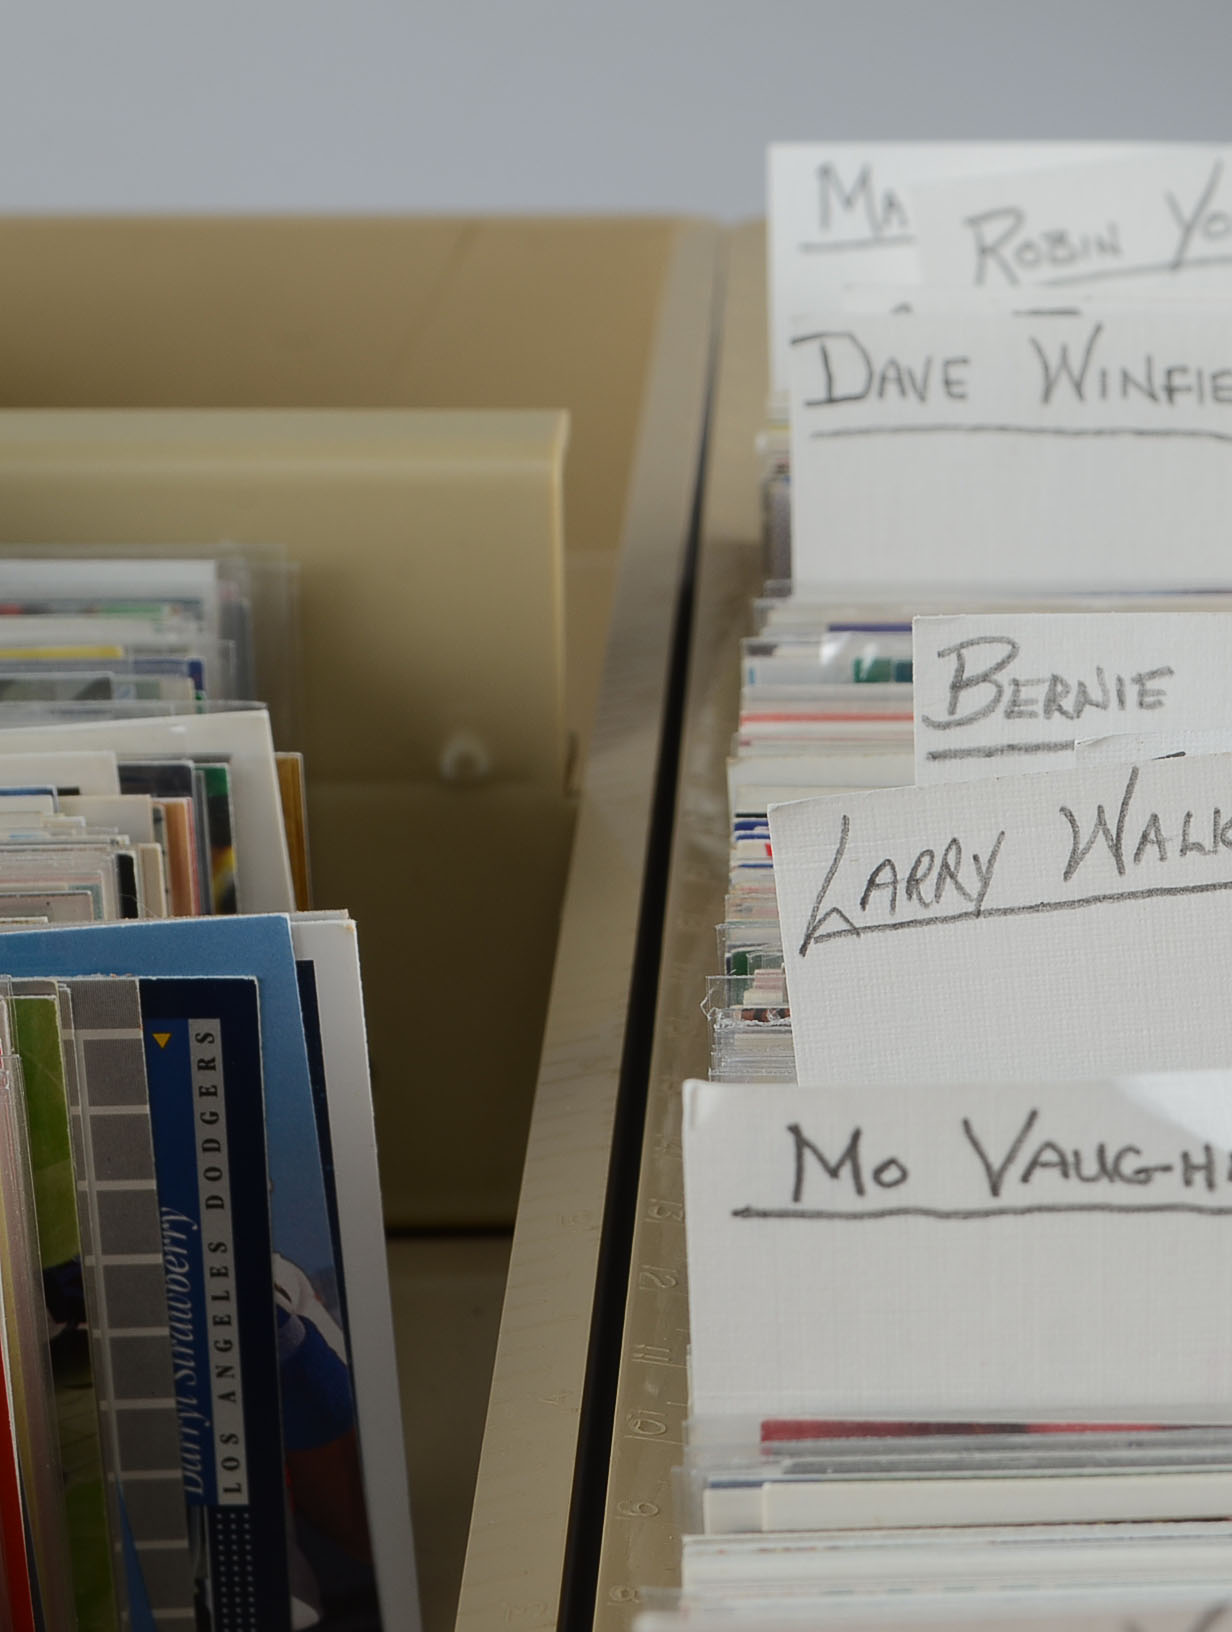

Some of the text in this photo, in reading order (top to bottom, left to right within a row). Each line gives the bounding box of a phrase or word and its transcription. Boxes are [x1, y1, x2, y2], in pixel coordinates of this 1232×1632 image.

[964, 206, 1122, 288] ROBIN
[790, 332, 974, 407] DAVE
[921, 635, 1175, 728] BERNIE
[798, 815, 1005, 958] LARRY
[195, 1031, 243, 1496] LOS ANGELES DODGERS
